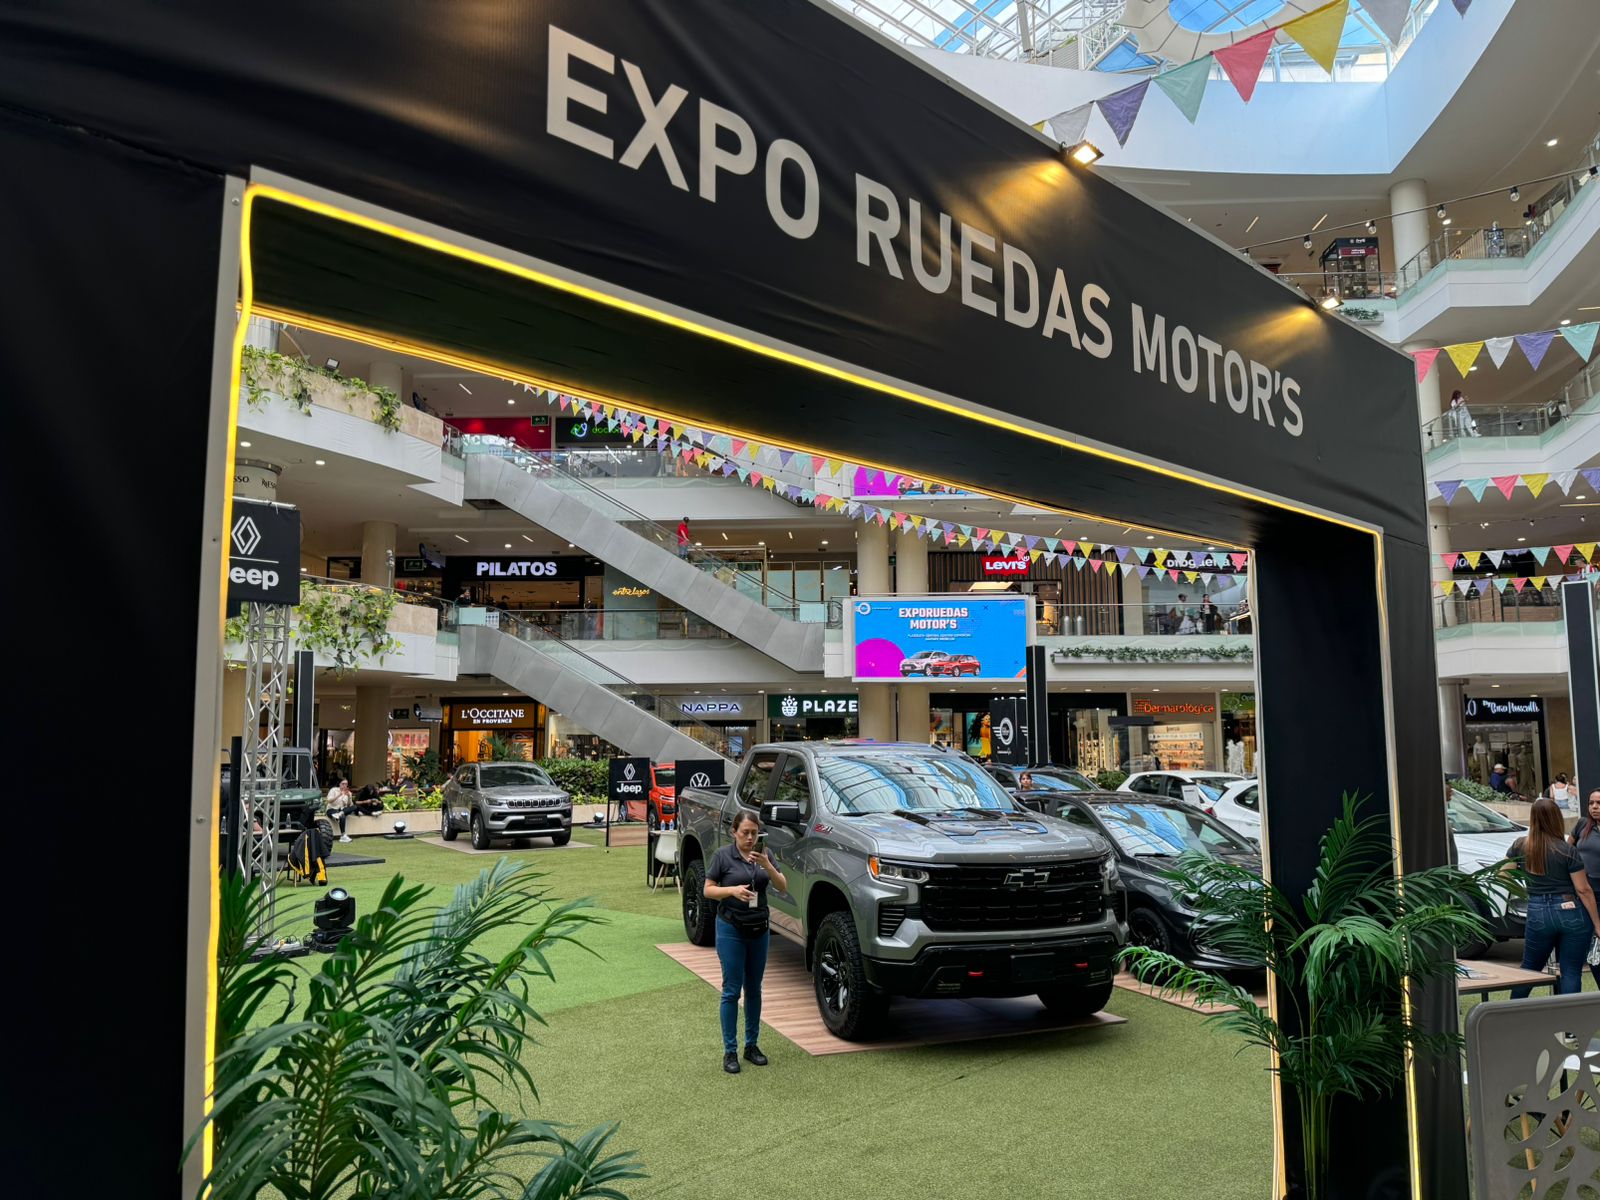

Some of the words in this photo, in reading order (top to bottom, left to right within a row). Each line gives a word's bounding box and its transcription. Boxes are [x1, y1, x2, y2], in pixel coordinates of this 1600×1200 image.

[547, 24, 820, 239] EXPO
[855, 172, 1113, 359] RUEDAS
[1131, 302, 1304, 437] MOTOR'S
[476, 562, 558, 576] PILATOS
[229, 567, 279, 591] eep
[899, 608, 968, 618] EXPORUEDAS
[910, 619, 957, 630] MOTOR'S
[682, 703, 740, 712] NAPPA
[461, 708, 525, 719] L'OCCITANE
[616, 784, 642, 794] Jeep
